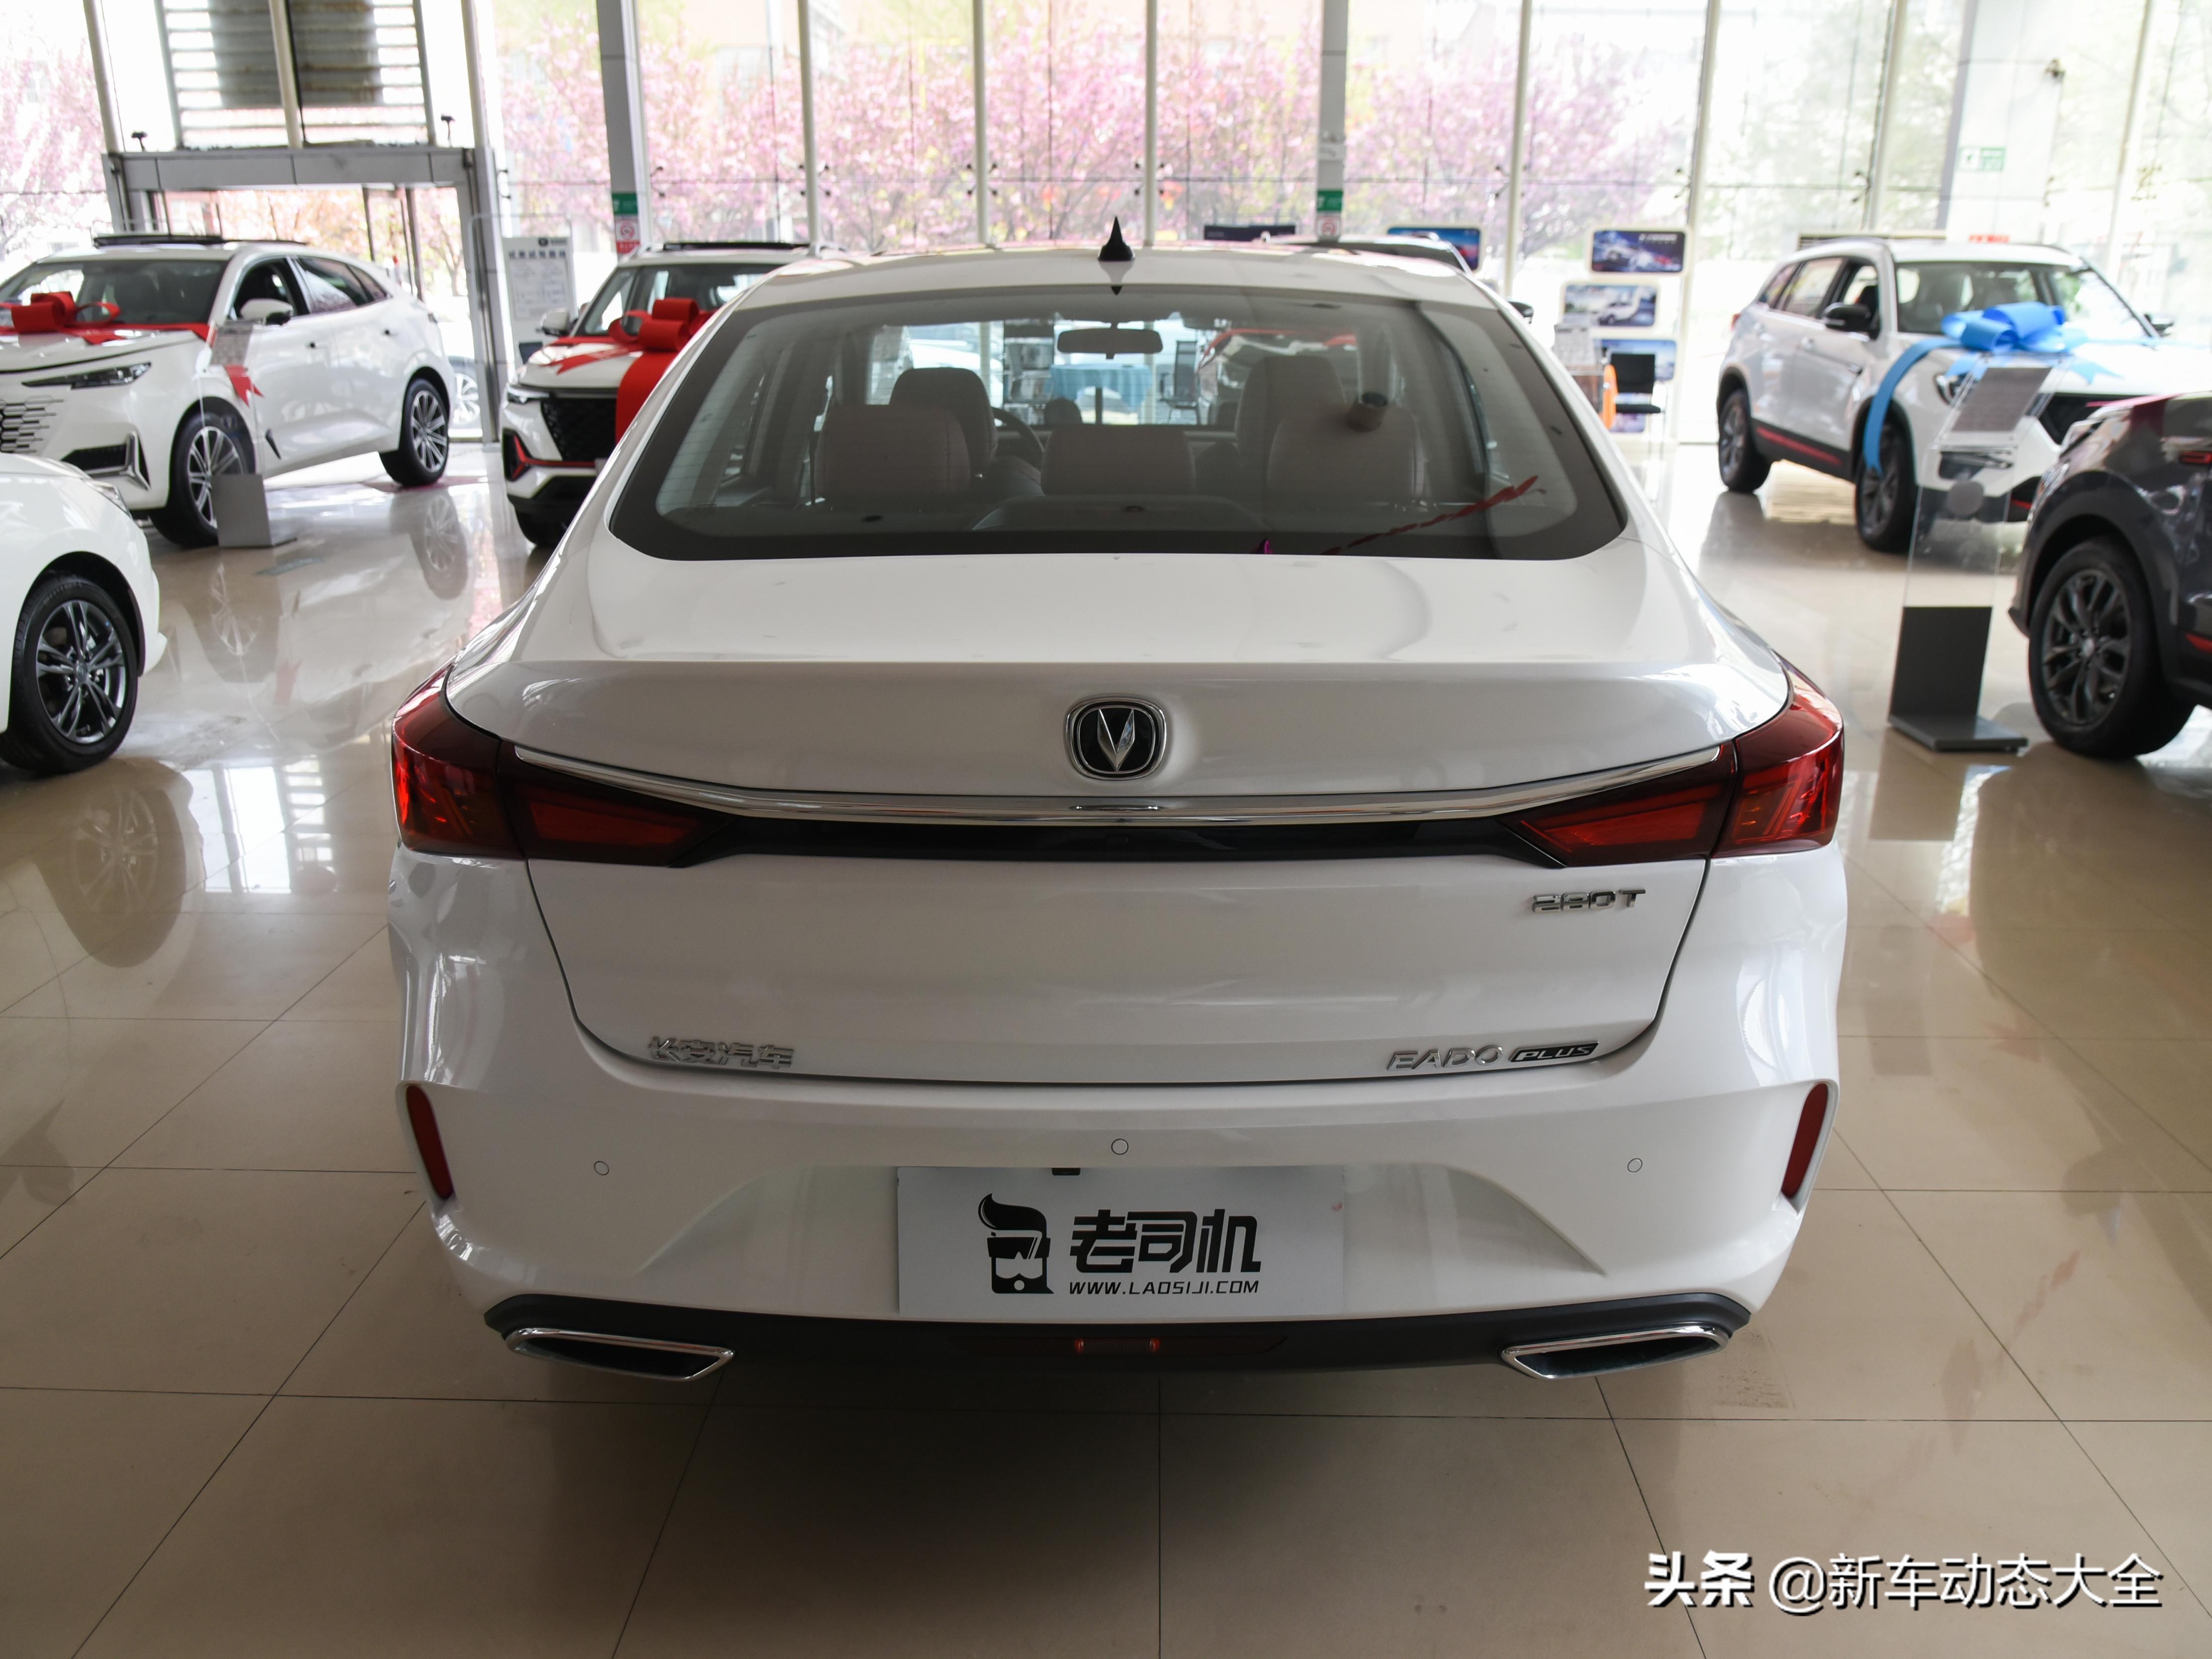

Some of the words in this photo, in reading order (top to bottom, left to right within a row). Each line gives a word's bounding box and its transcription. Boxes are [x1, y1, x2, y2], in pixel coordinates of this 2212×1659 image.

[1532, 889, 1646, 913] 280T
[648, 1036, 794, 1069] 长安汽车
[1387, 1045, 1504, 1071] EADO
[1515, 1046, 1594, 1061] PLUS
[1069, 1209, 1261, 1273] 老司机
[1069, 1280, 1259, 1295] WWW.LAOSIJI.COM
